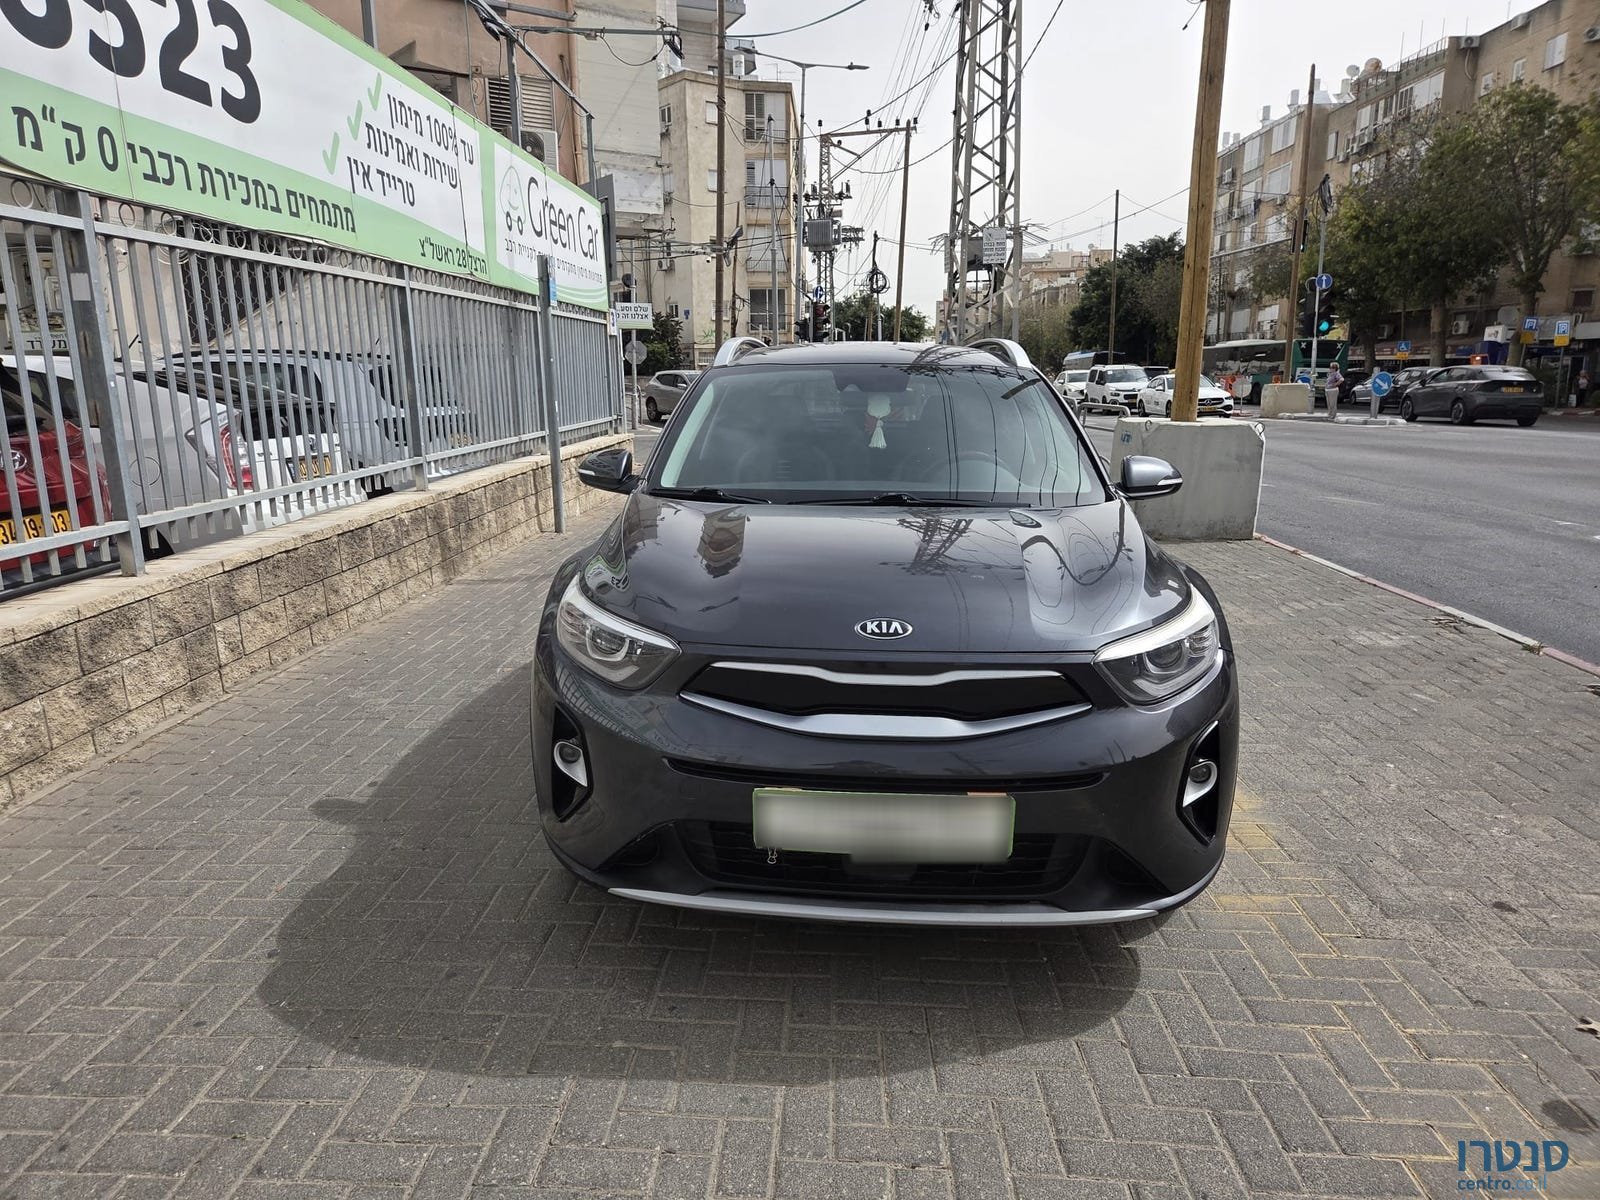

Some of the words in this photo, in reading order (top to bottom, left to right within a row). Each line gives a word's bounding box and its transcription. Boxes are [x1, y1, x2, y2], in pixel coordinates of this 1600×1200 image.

[387, 93, 423, 137] מימון
[426, 114, 459, 157] 100%
[97, 125, 119, 172] 0
[126, 142, 193, 191] רכבי
[365, 121, 421, 172] ואמינות
[460, 138, 474, 165] עד
[197, 162, 283, 214] במכירת
[347, 155, 374, 194] אין
[376, 168, 415, 207] טרייד
[423, 151, 458, 190] שירות
[285, 188, 356, 233] מתמחים
[527, 176, 577, 252] Green
[577, 206, 599, 262] Car
[456, 247, 467, 269] 28
[505, 238, 517, 254] רכב
[866, 620, 904, 634] KIA
